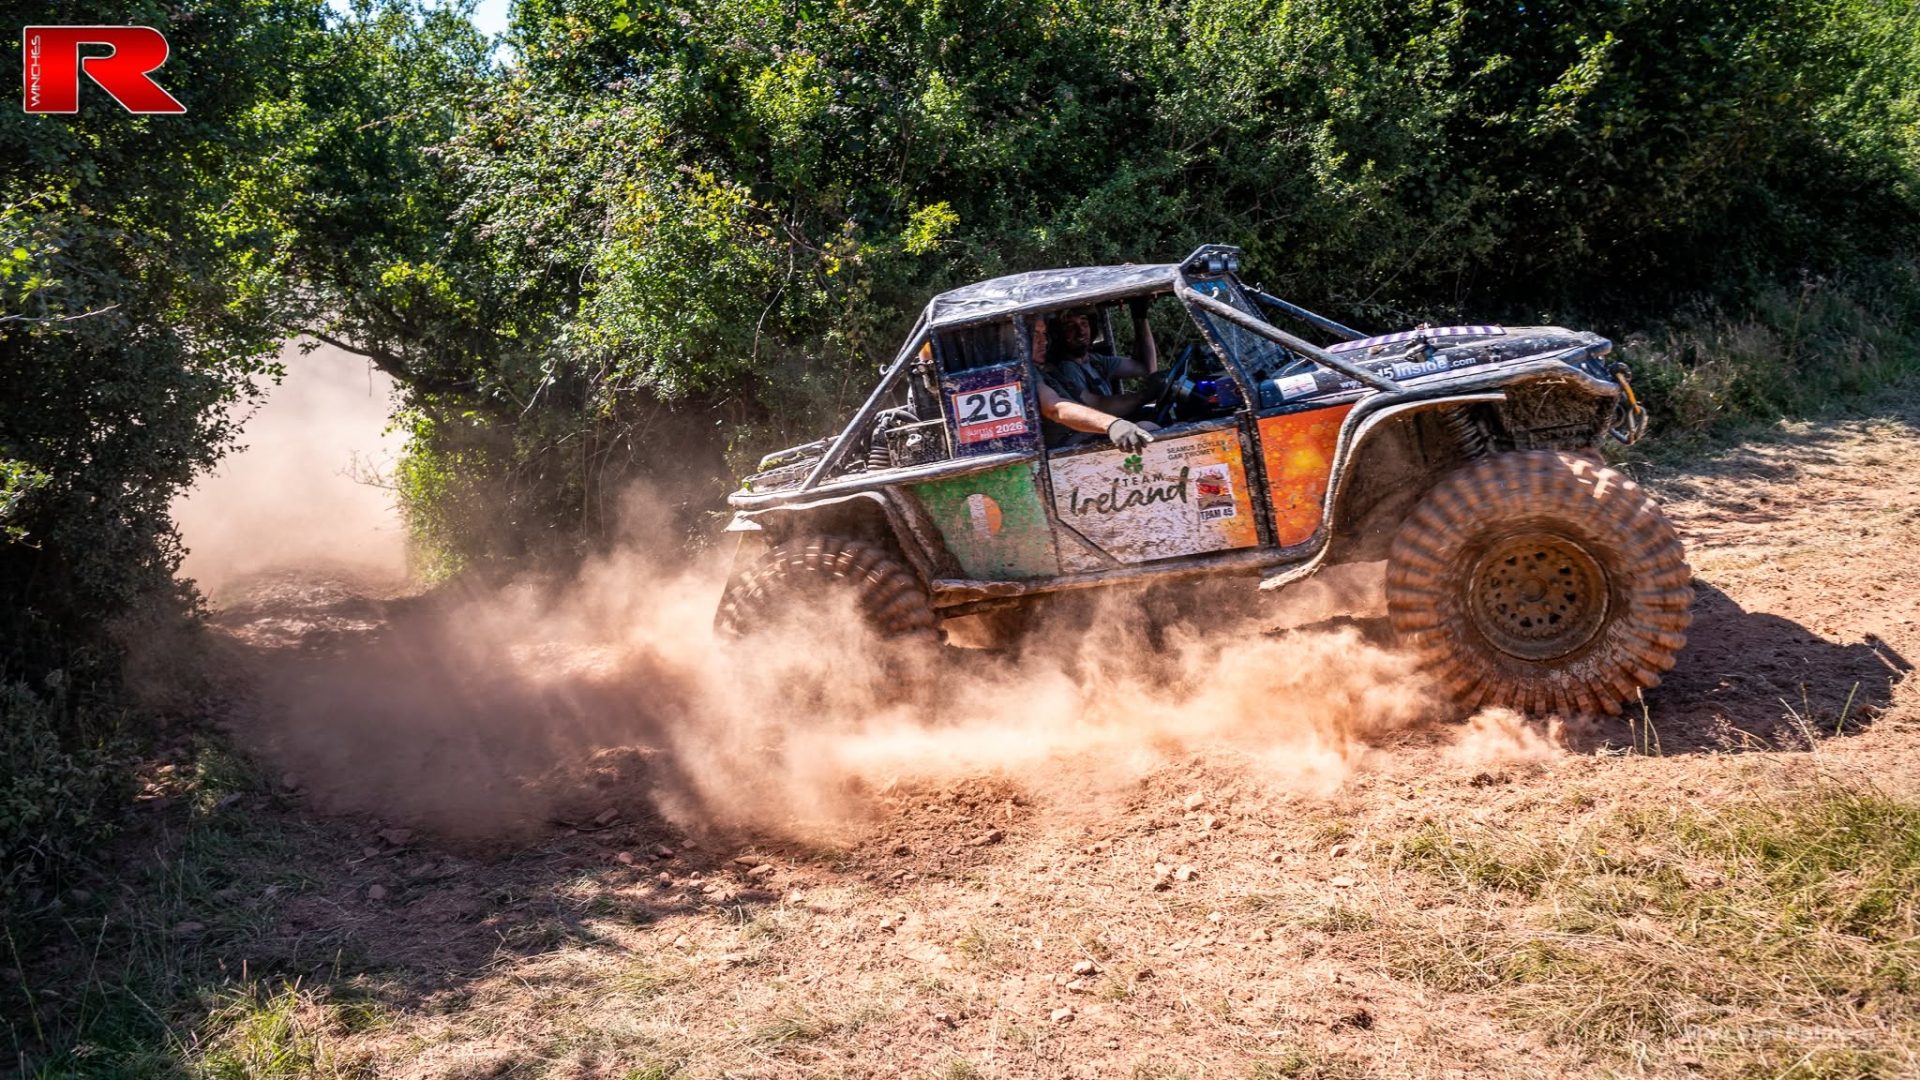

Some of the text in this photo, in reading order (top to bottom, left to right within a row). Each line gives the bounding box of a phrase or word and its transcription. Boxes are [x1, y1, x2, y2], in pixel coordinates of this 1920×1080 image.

[962, 389, 1012, 422] 26
[995, 422, 1023, 434] 2026
[1122, 473, 1164, 487] TEAM
[1070, 466, 1190, 515] Ireland
[1200, 509, 1221, 520] TEAM
